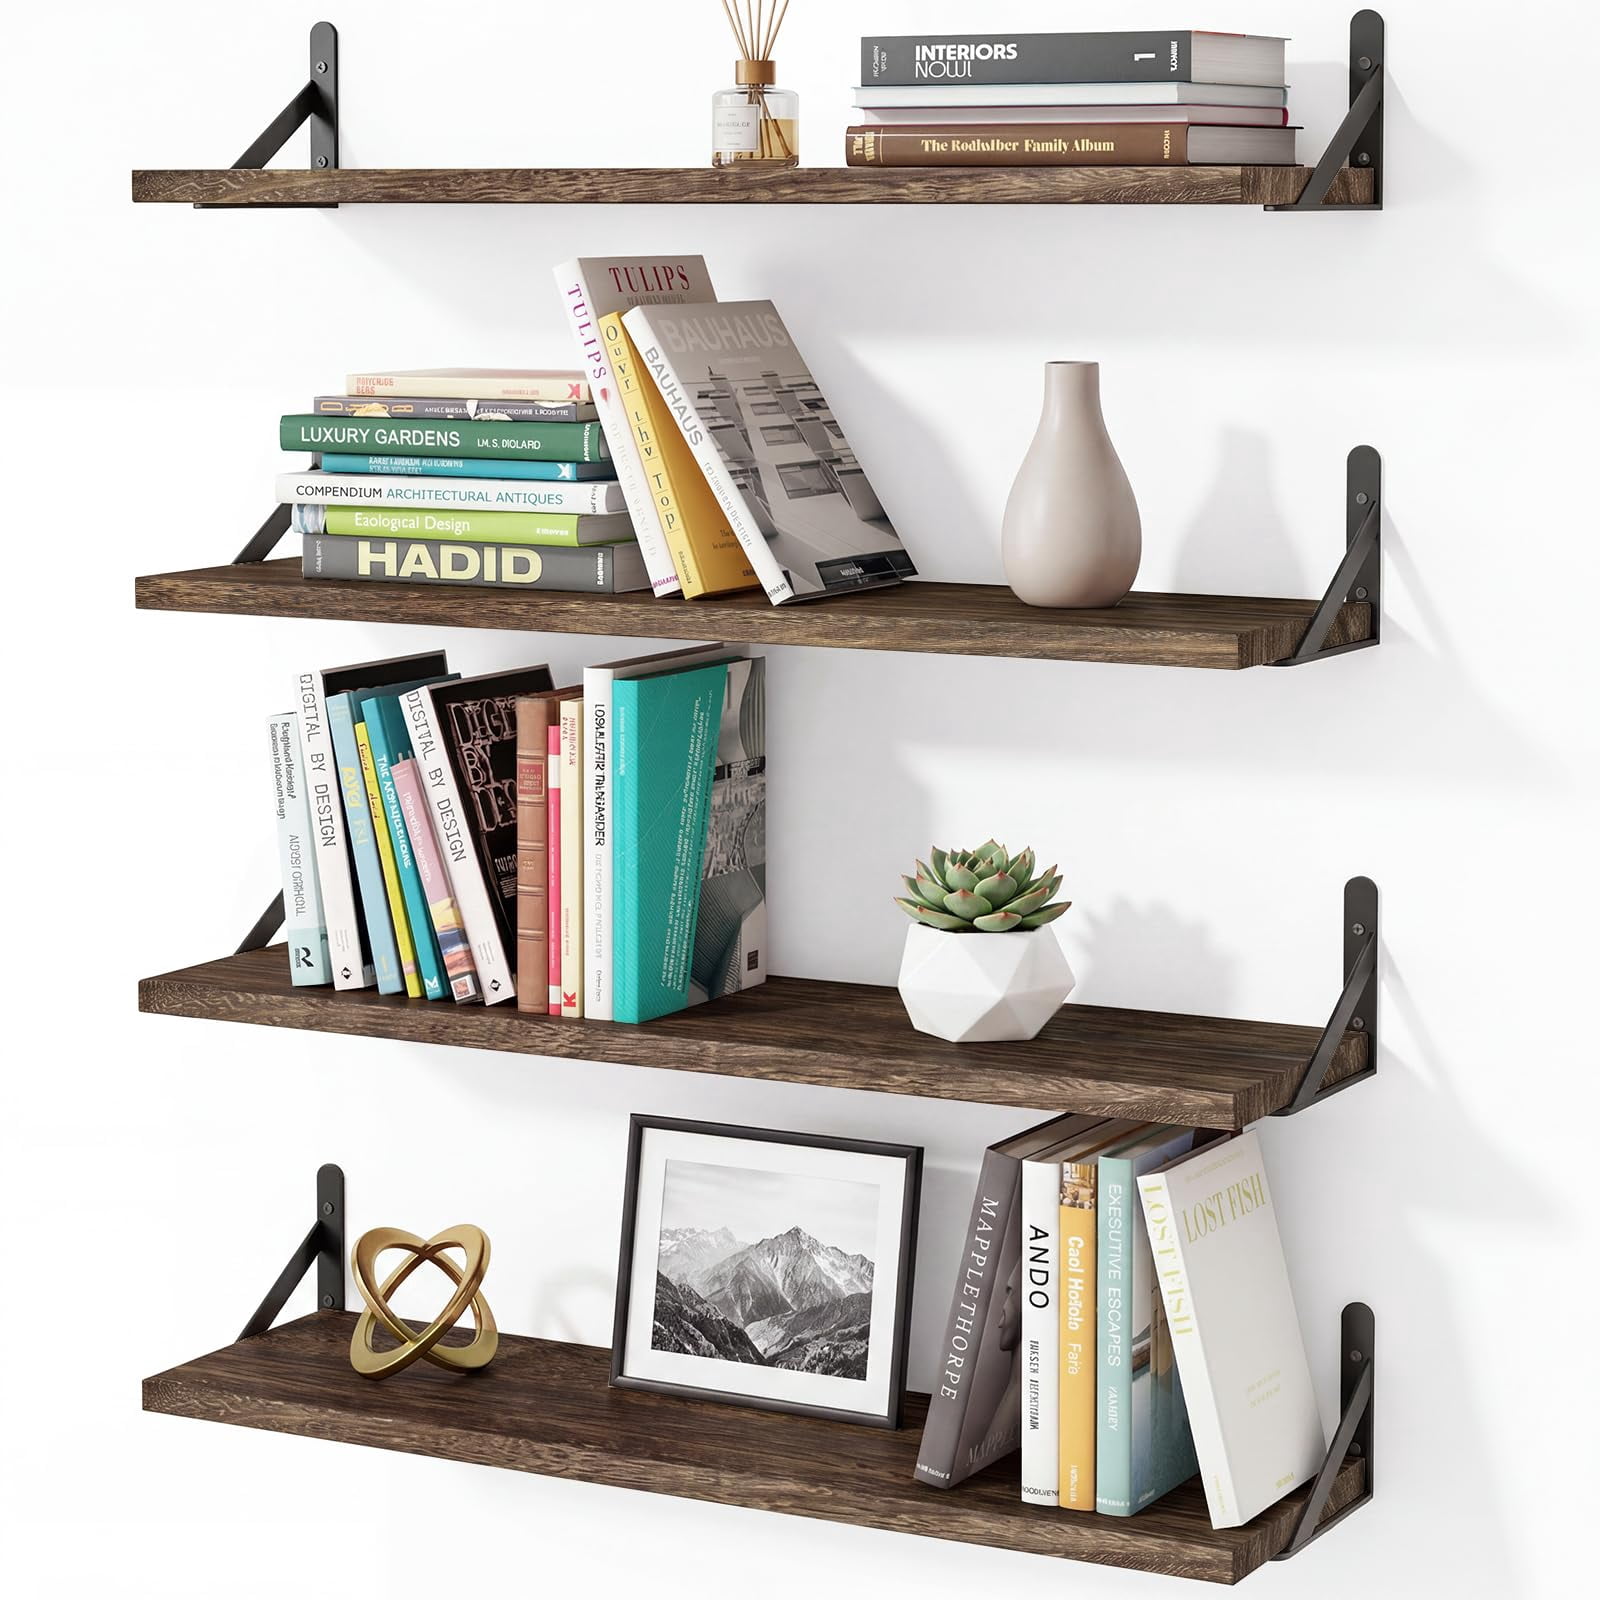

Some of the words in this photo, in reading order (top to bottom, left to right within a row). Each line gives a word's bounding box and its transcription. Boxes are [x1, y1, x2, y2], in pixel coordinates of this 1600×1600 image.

[915, 43, 1017, 61] INTERIORS
[920, 139, 948, 152] The
[1024, 138, 1069, 154] Family
[1071, 138, 1114, 152] Album
[608, 264, 690, 293] TULIPS
[567, 283, 607, 379] TULIPS
[656, 313, 789, 352] BAUHAUS
[644, 346, 704, 446] BAUHAUS
[300, 426, 369, 444] LUXURY
[374, 428, 460, 447] GARDENS
[296, 485, 383, 499] COMPENDIUM
[386, 488, 492, 502] ARCHITECTURAL
[495, 491, 563, 506] ANTIQUES
[424, 515, 470, 535] Design
[357, 541, 543, 584] HADID
[310, 752, 326, 772] BY
[314, 783, 337, 847] DESIGN
[428, 767, 446, 789] BY
[437, 797, 467, 863] DESIGN
[1107, 1183, 1122, 1281] EXESUTIVE
[1182, 1190, 1226, 1245] LOST
[1226, 1172, 1267, 1222] FISH
[1028, 1224, 1050, 1310] ANDO
[939, 1195, 1000, 1401] MAPPLETHORPE
[1107, 1287, 1121, 1368] ESCAPES
